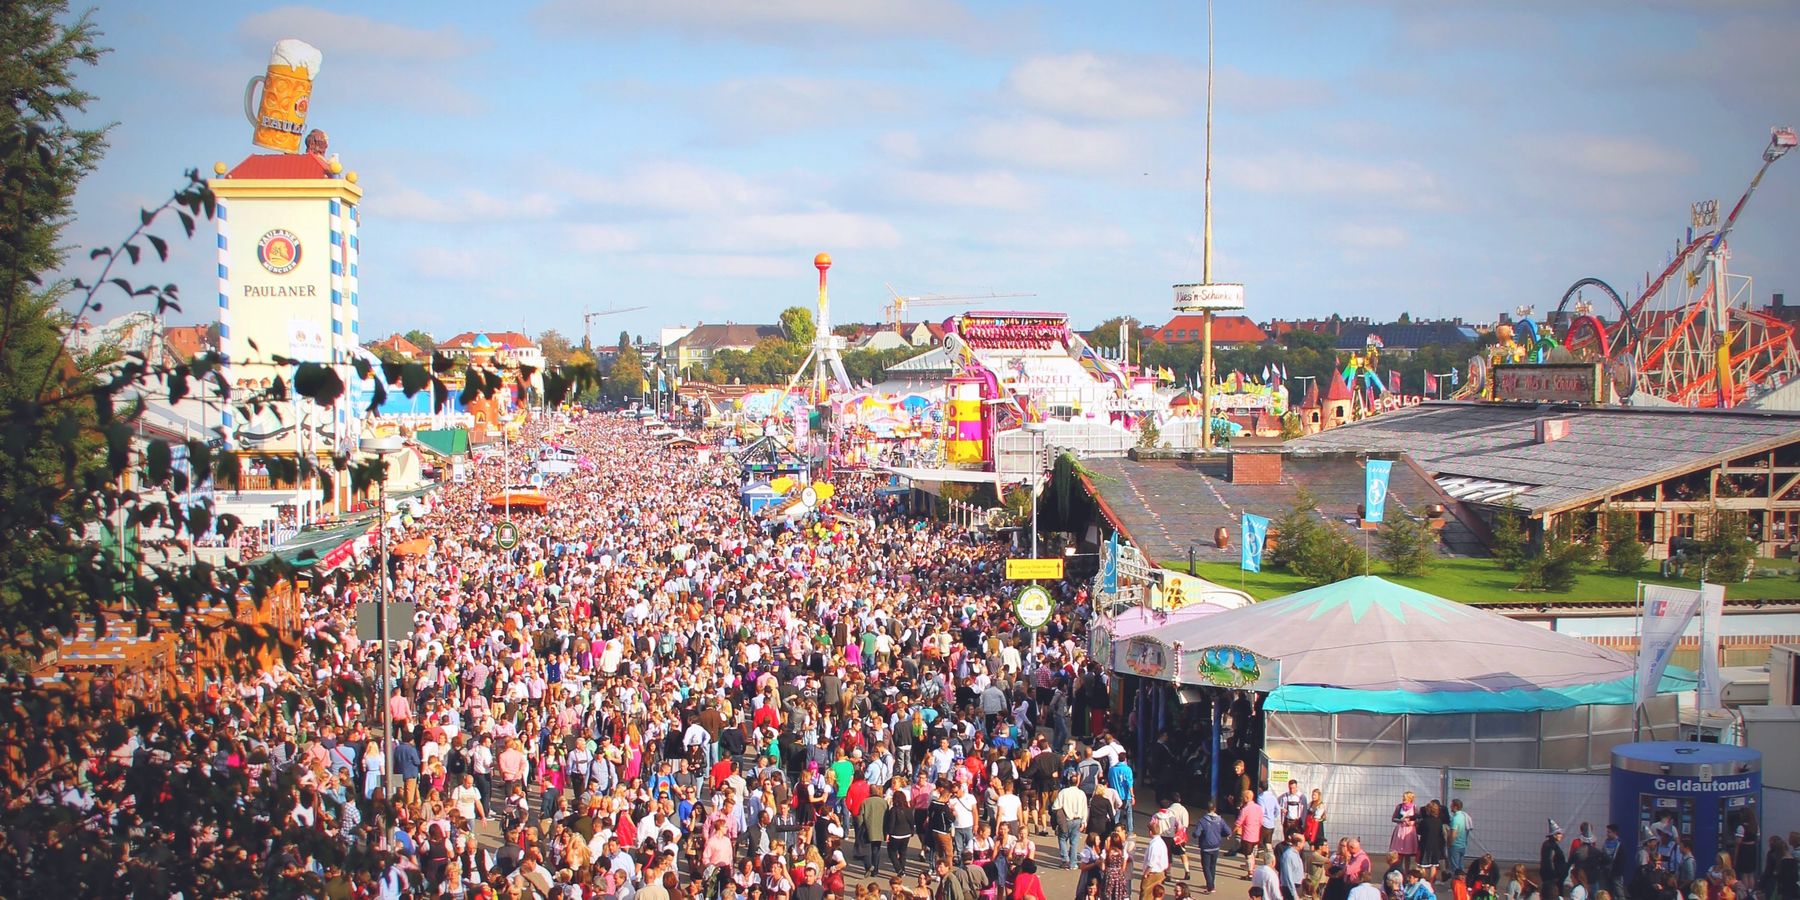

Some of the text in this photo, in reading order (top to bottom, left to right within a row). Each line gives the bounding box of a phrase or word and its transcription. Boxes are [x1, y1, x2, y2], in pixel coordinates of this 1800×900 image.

[258, 229, 300, 247] PAULANER
[243, 284, 317, 297] PAULANER
[1654, 778, 1751, 792] Geldautomat
